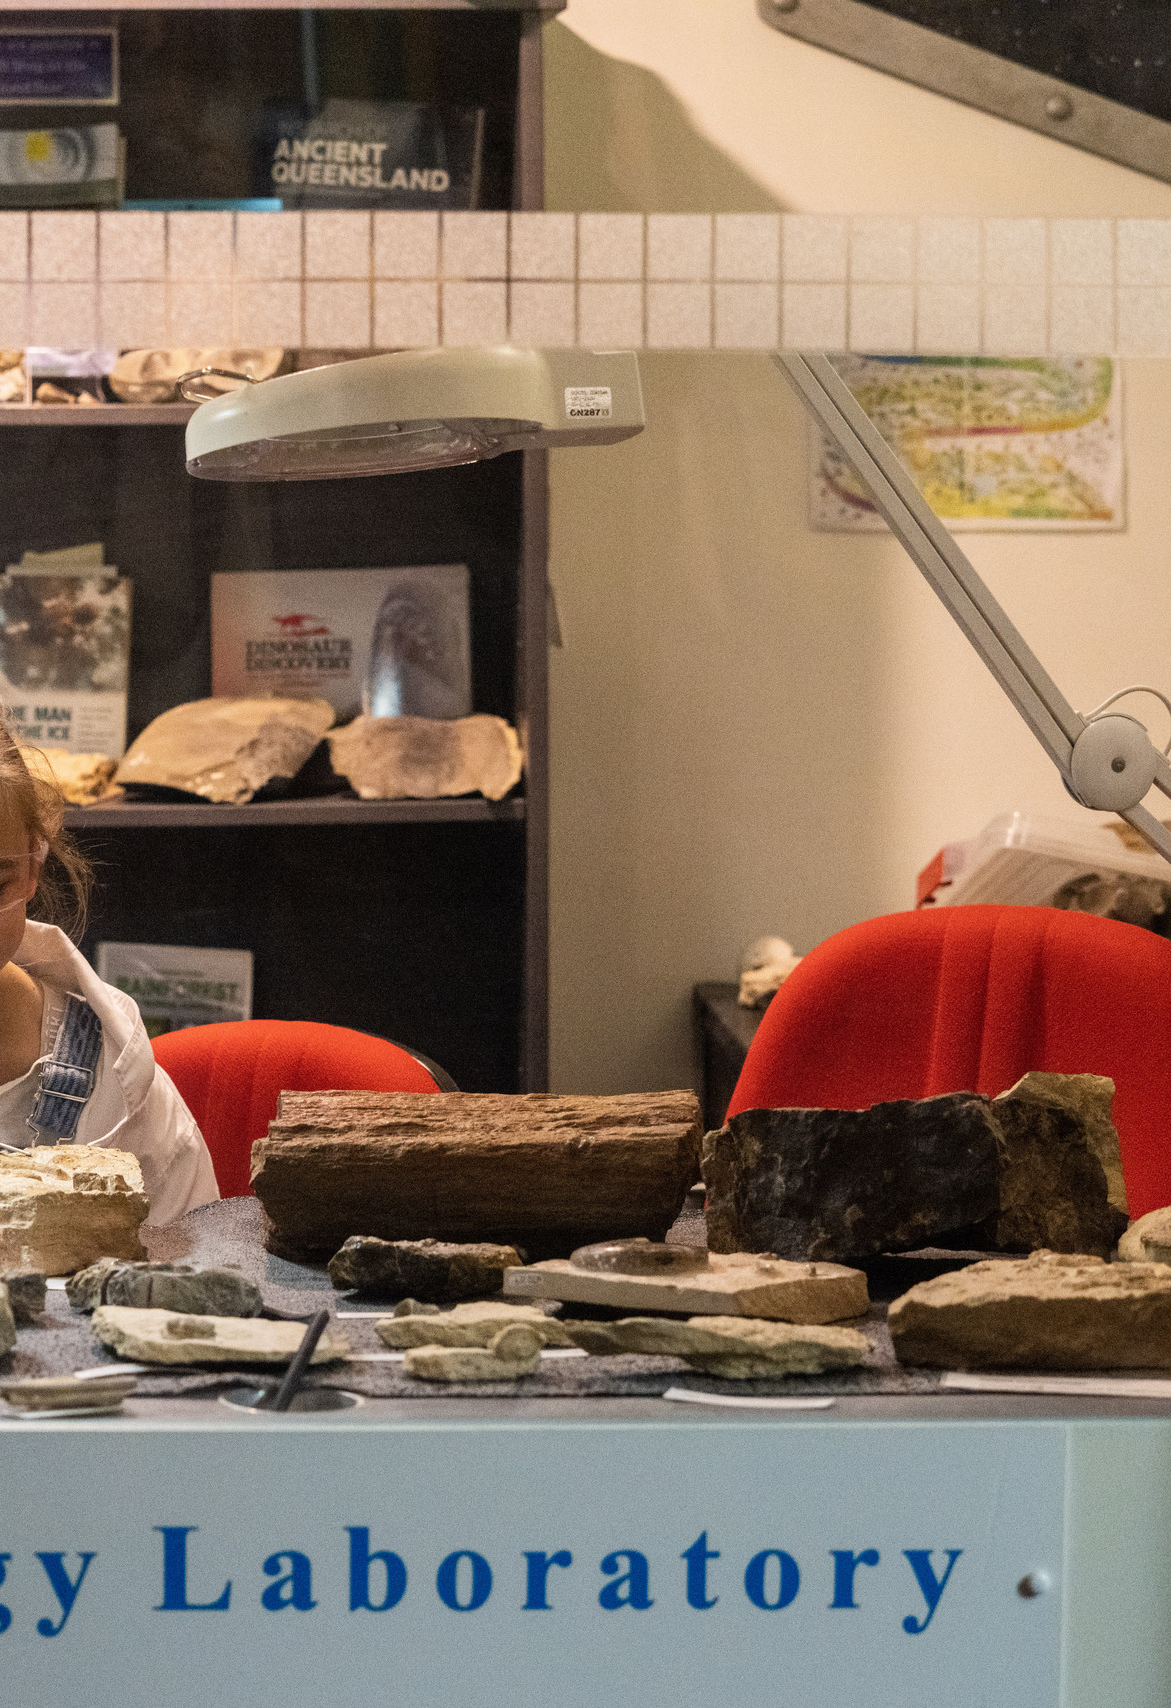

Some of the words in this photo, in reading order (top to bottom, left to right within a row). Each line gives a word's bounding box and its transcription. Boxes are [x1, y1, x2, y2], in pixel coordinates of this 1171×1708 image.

[273, 138, 387, 164] ANCIENT
[271, 161, 450, 192] QUEENSLAND
[34, 706, 72, 721] MAN
[47, 727, 70, 740] ICE
[158, 1525, 964, 1636] Laboratory
